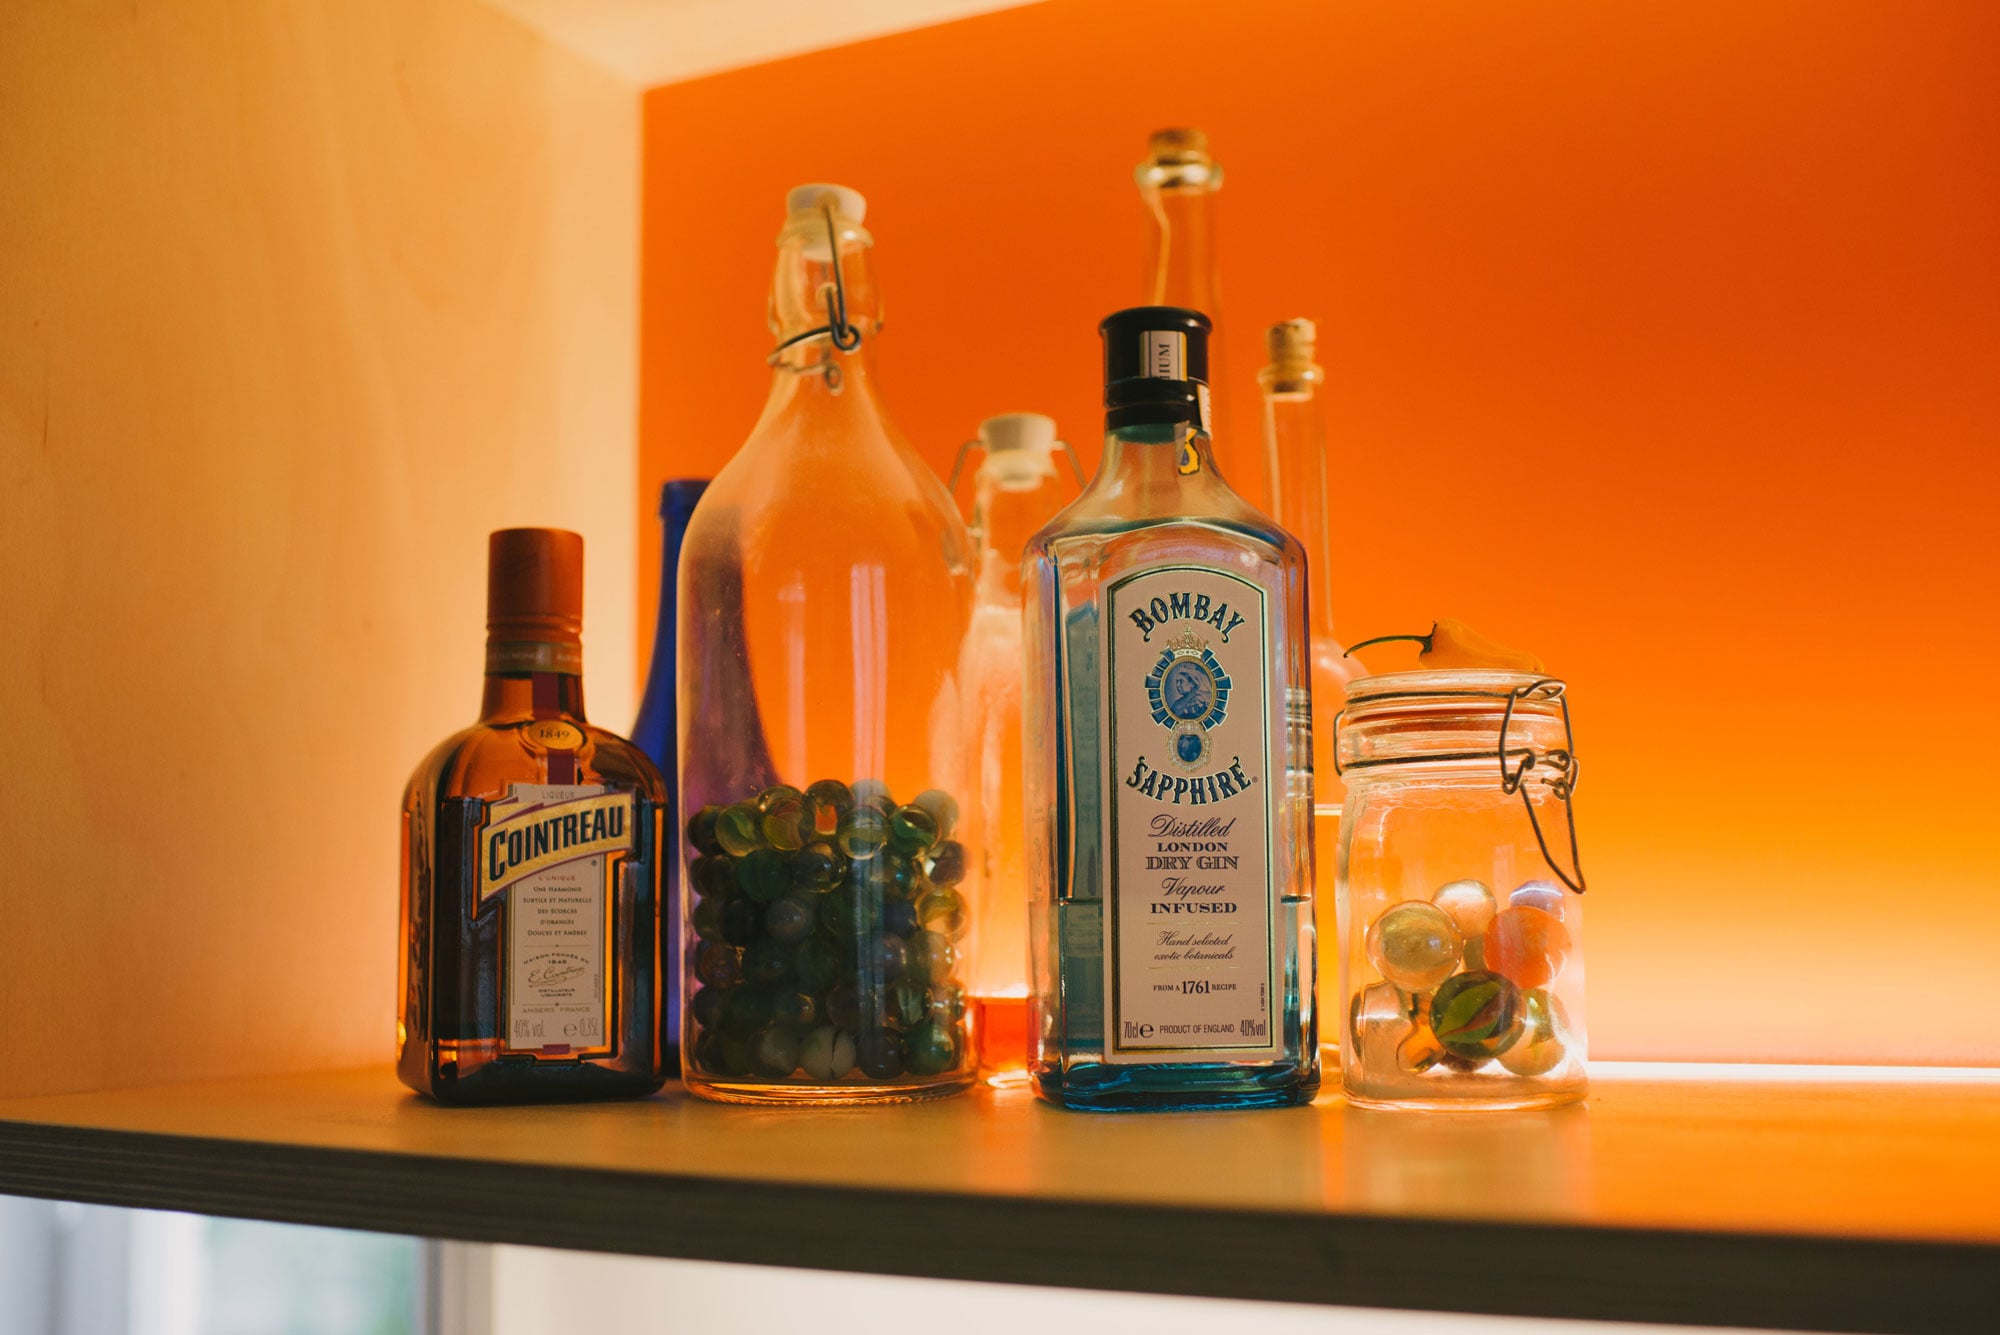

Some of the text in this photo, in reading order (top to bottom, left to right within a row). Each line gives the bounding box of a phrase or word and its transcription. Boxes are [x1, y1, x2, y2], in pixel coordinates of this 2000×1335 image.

[1128, 592, 1246, 643] BOMBAY
[539, 729, 571, 740] 1849
[1125, 755, 1252, 805] SAPPHIRE
[541, 790, 575, 800] LIQUEUR
[1147, 813, 1238, 838] Distilled
[488, 805, 625, 882] COINTREAU
[1156, 841, 1229, 853] LONDON
[1145, 855, 1240, 870] DRY GIN
[1161, 876, 1226, 901] Vapour
[1149, 902, 1238, 914] INFUSED
[1156, 930, 1234, 946] Hand selected
[1153, 946, 1237, 961] exotic botanicals
[1153, 980, 1237, 995] FROM A 1761 RECIPE
[513, 1018, 531, 1038] 40%
[1123, 1020, 1139, 1039] 70cl
[1159, 1024, 1191, 1034] PRODUCT
[1193, 1024, 1202, 1034] OF
[1204, 1023, 1235, 1034] ENGLAND
